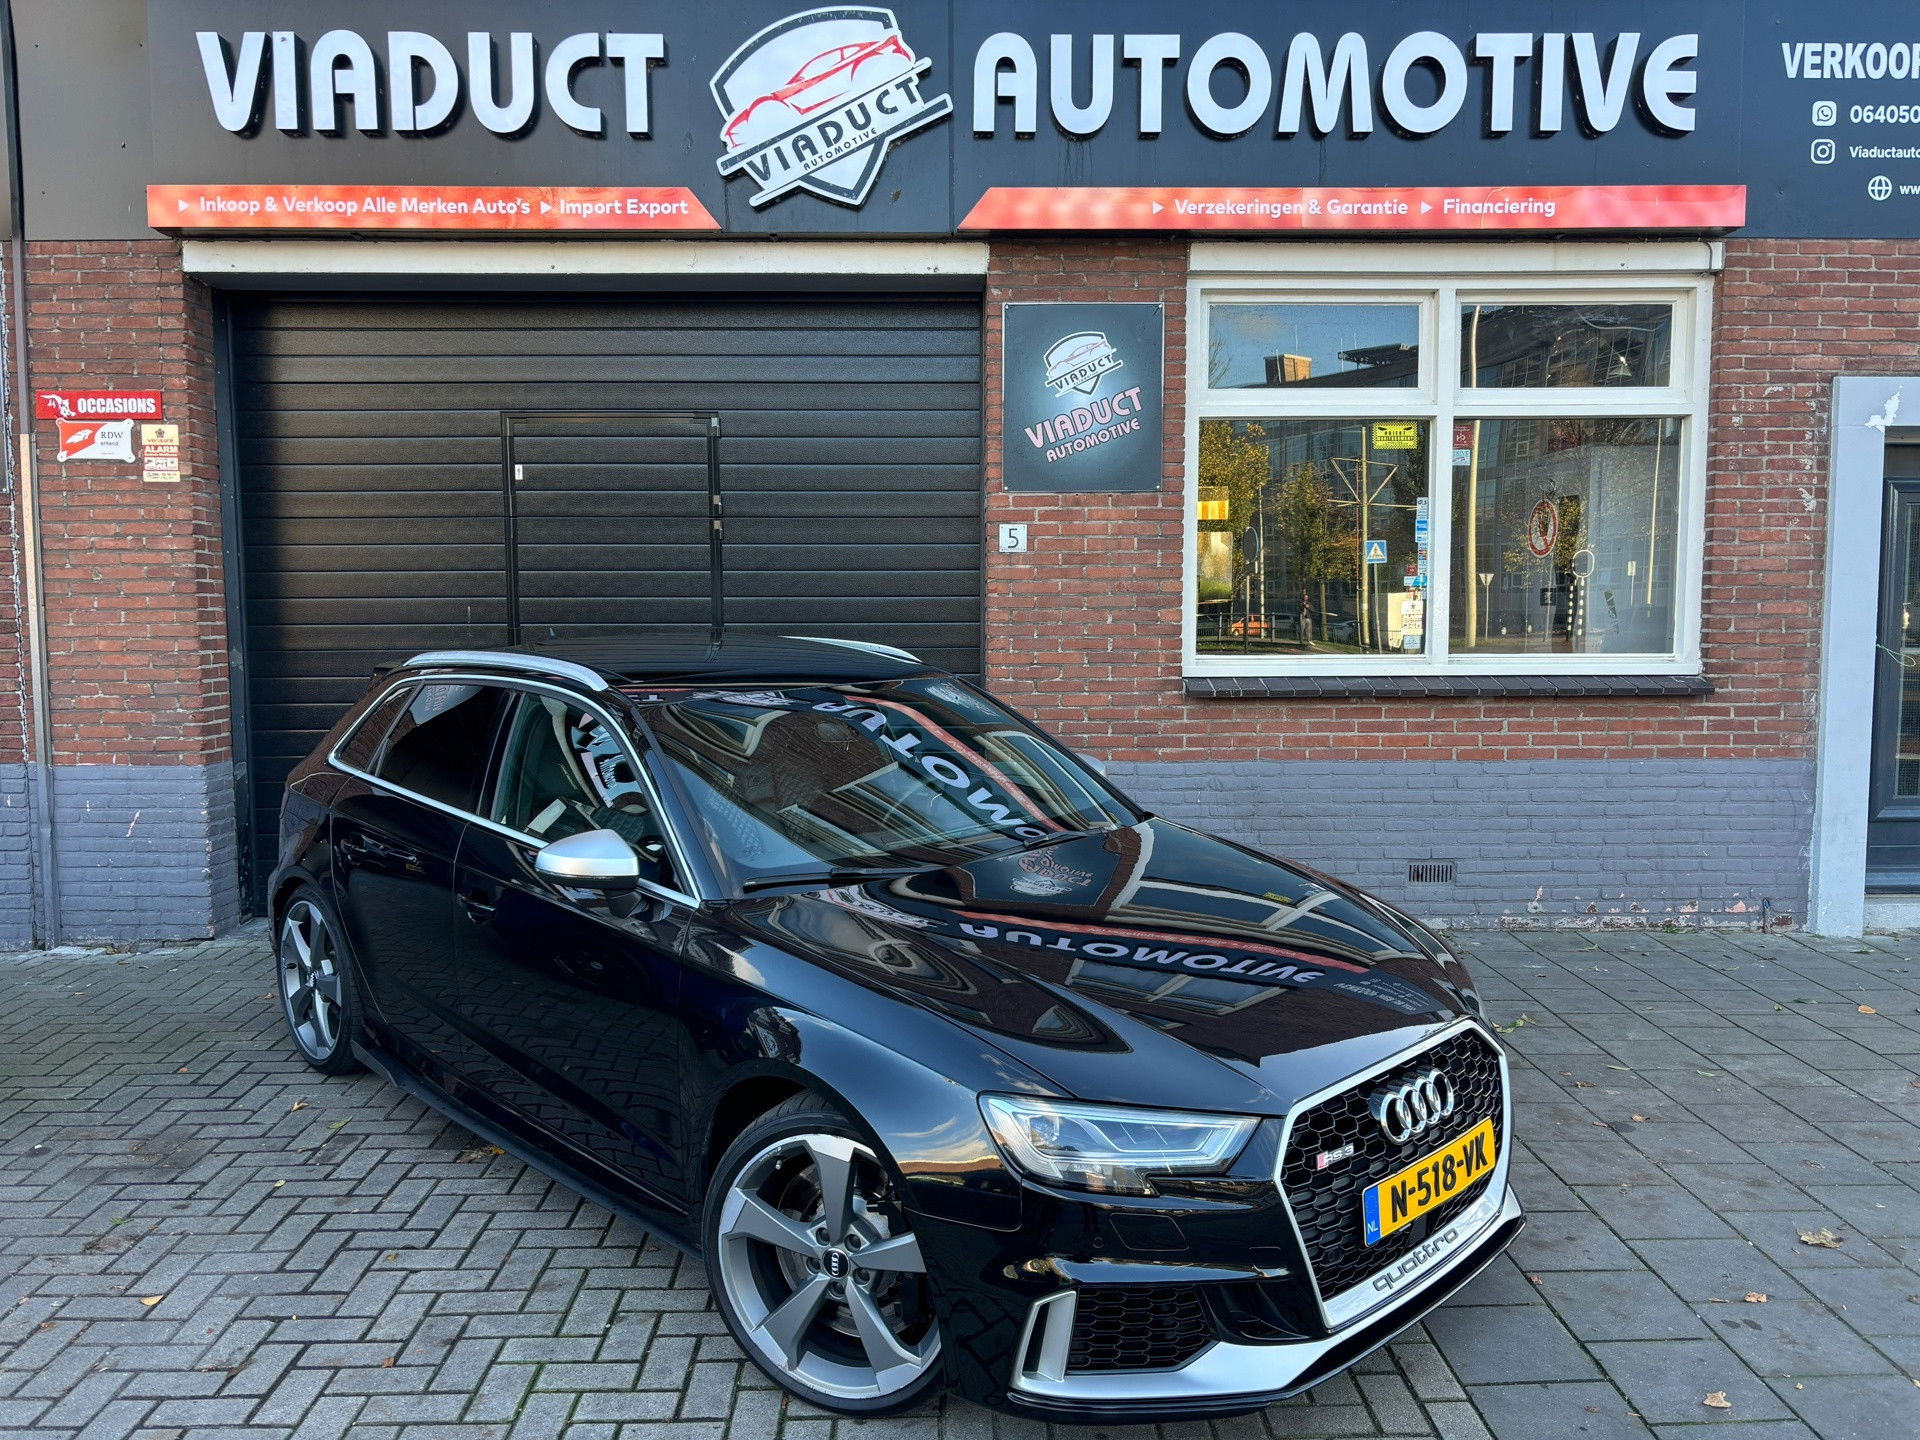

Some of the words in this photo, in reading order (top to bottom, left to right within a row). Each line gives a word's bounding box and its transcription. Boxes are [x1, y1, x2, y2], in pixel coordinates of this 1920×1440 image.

[196, 30, 666, 136] VIADUCT
[973, 31, 1699, 136] AUTOMOTIVE
[1850, 105, 1920, 124] 064050
[746, 77, 918, 181] VIADUCT
[803, 127, 877, 171] AUTOMOTIVE
[200, 196, 261, 215] Inkoop
[265, 196, 279, 213] &
[282, 196, 358, 216] Verkoop
[362, 197, 396, 213] Alle
[401, 197, 468, 213] Merken
[472, 197, 531, 214] Auto's
[560, 199, 622, 218] Import
[626, 199, 688, 217] Export
[1174, 198, 1303, 216] Verzekeringen
[1308, 199, 1322, 215] &
[1326, 199, 1409, 215] Garantie
[1443, 198, 1556, 217] Financiering
[1055, 354, 1112, 389] VIADUCT
[77, 398, 156, 413] OCCASIONS
[1025, 387, 1143, 448] VIADUCT
[100, 431, 124, 439] RDW
[1046, 418, 1141, 462] AUTOMOTIVE
[144, 445, 179, 453] ALARM
[1007, 528, 1019, 549] 5
[1391, 1132, 1488, 1223] N-518-VK
[1367, 1222, 1379, 1235] NL
[1372, 1228, 1459, 1291] quattro
